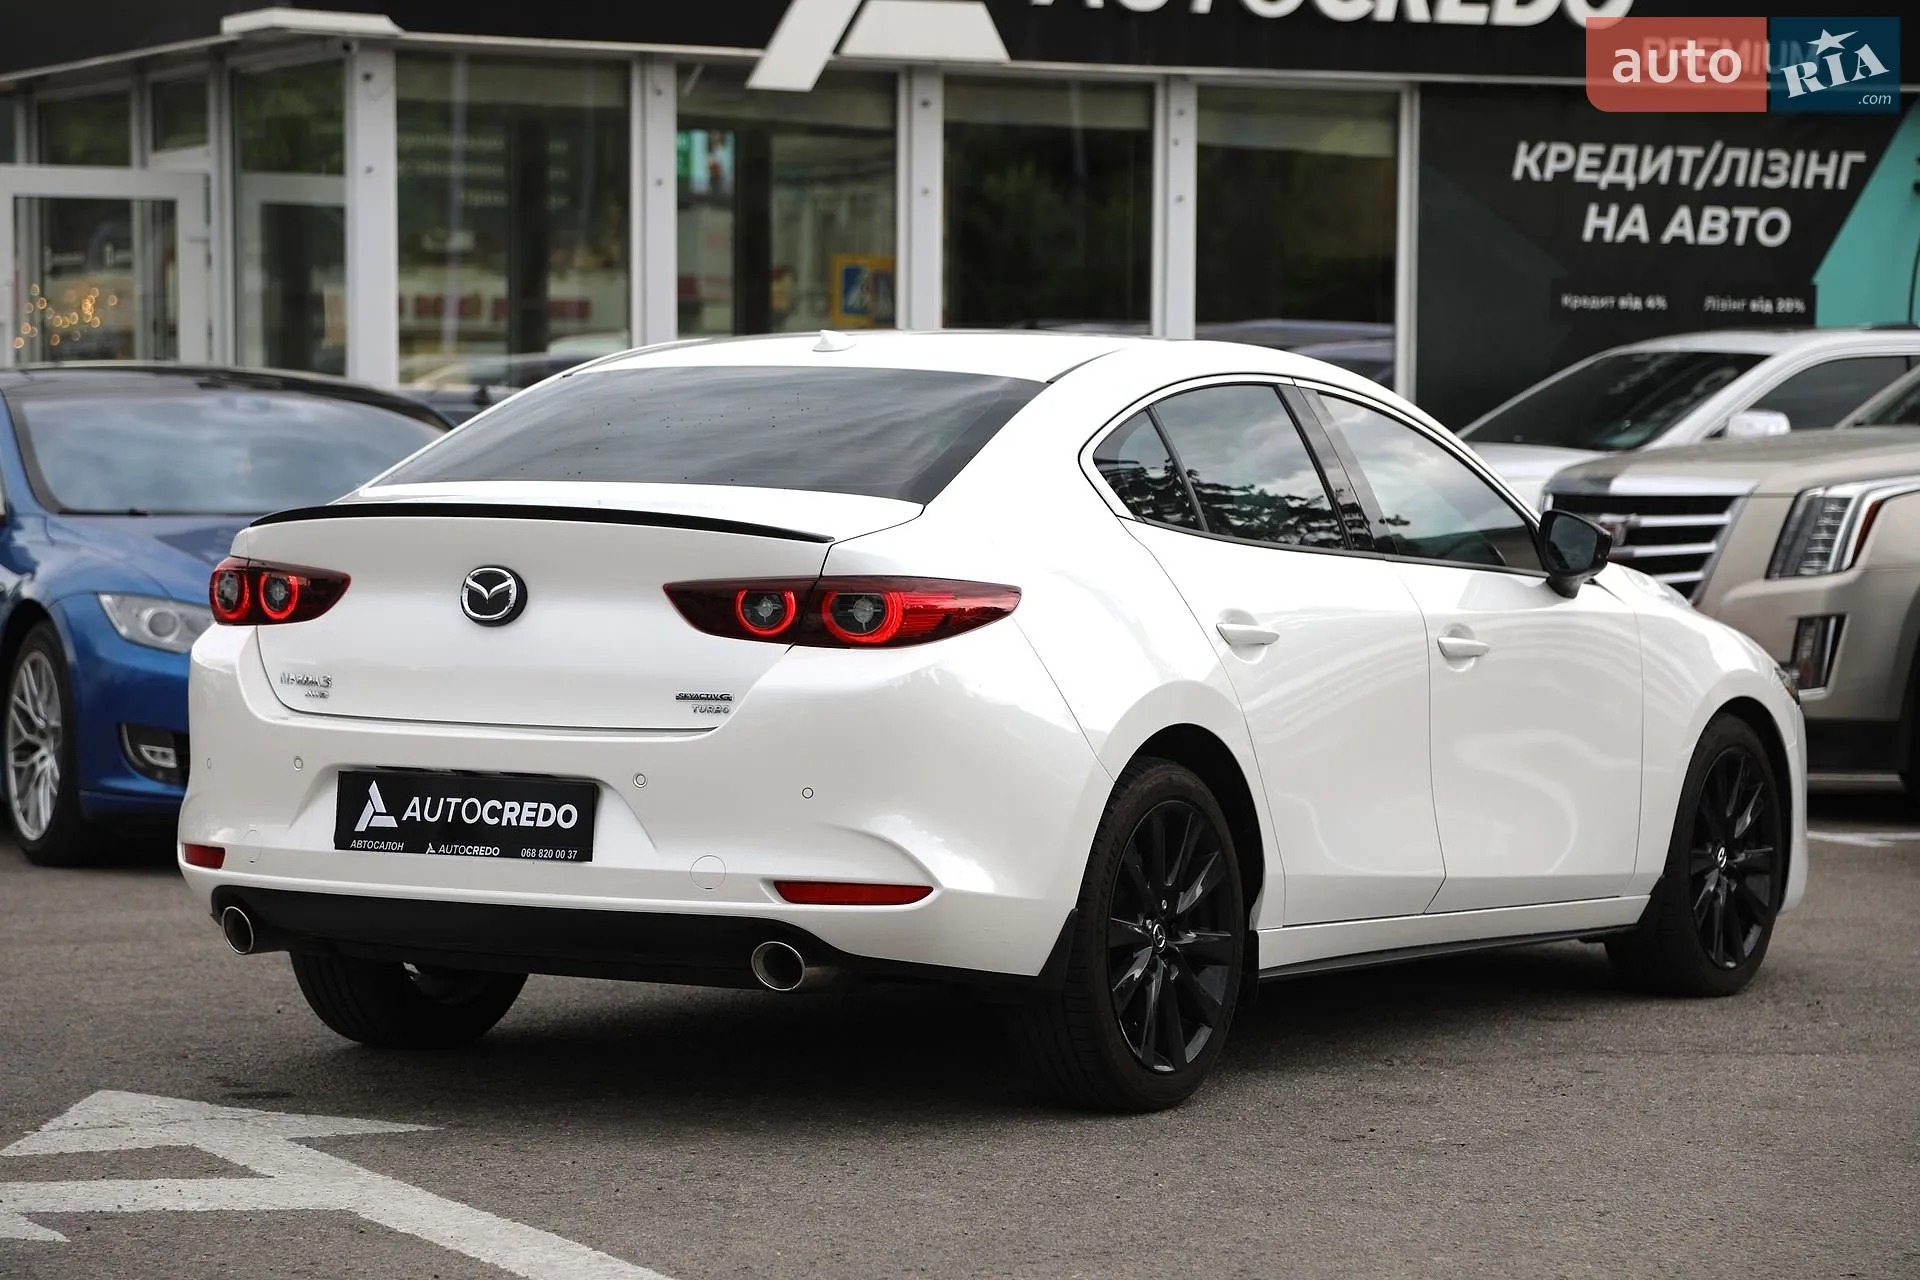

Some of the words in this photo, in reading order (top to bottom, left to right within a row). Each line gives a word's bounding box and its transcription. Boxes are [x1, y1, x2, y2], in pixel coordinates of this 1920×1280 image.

[1512, 140, 1867, 192] КРЕДИТ/ЛІЗІНГ
[1582, 202, 1650, 244] НА
[1659, 204, 1793, 248] АВТО
[402, 796, 579, 830] AUTOCREDO
[350, 838, 405, 852] АВТОСАЛОН
[437, 843, 500, 857] AUTOCREDO
[520, 848, 537, 858] 068
[538, 848, 554, 859] 820
[555, 849, 566, 859] 00
[567, 850, 578, 860] 37
